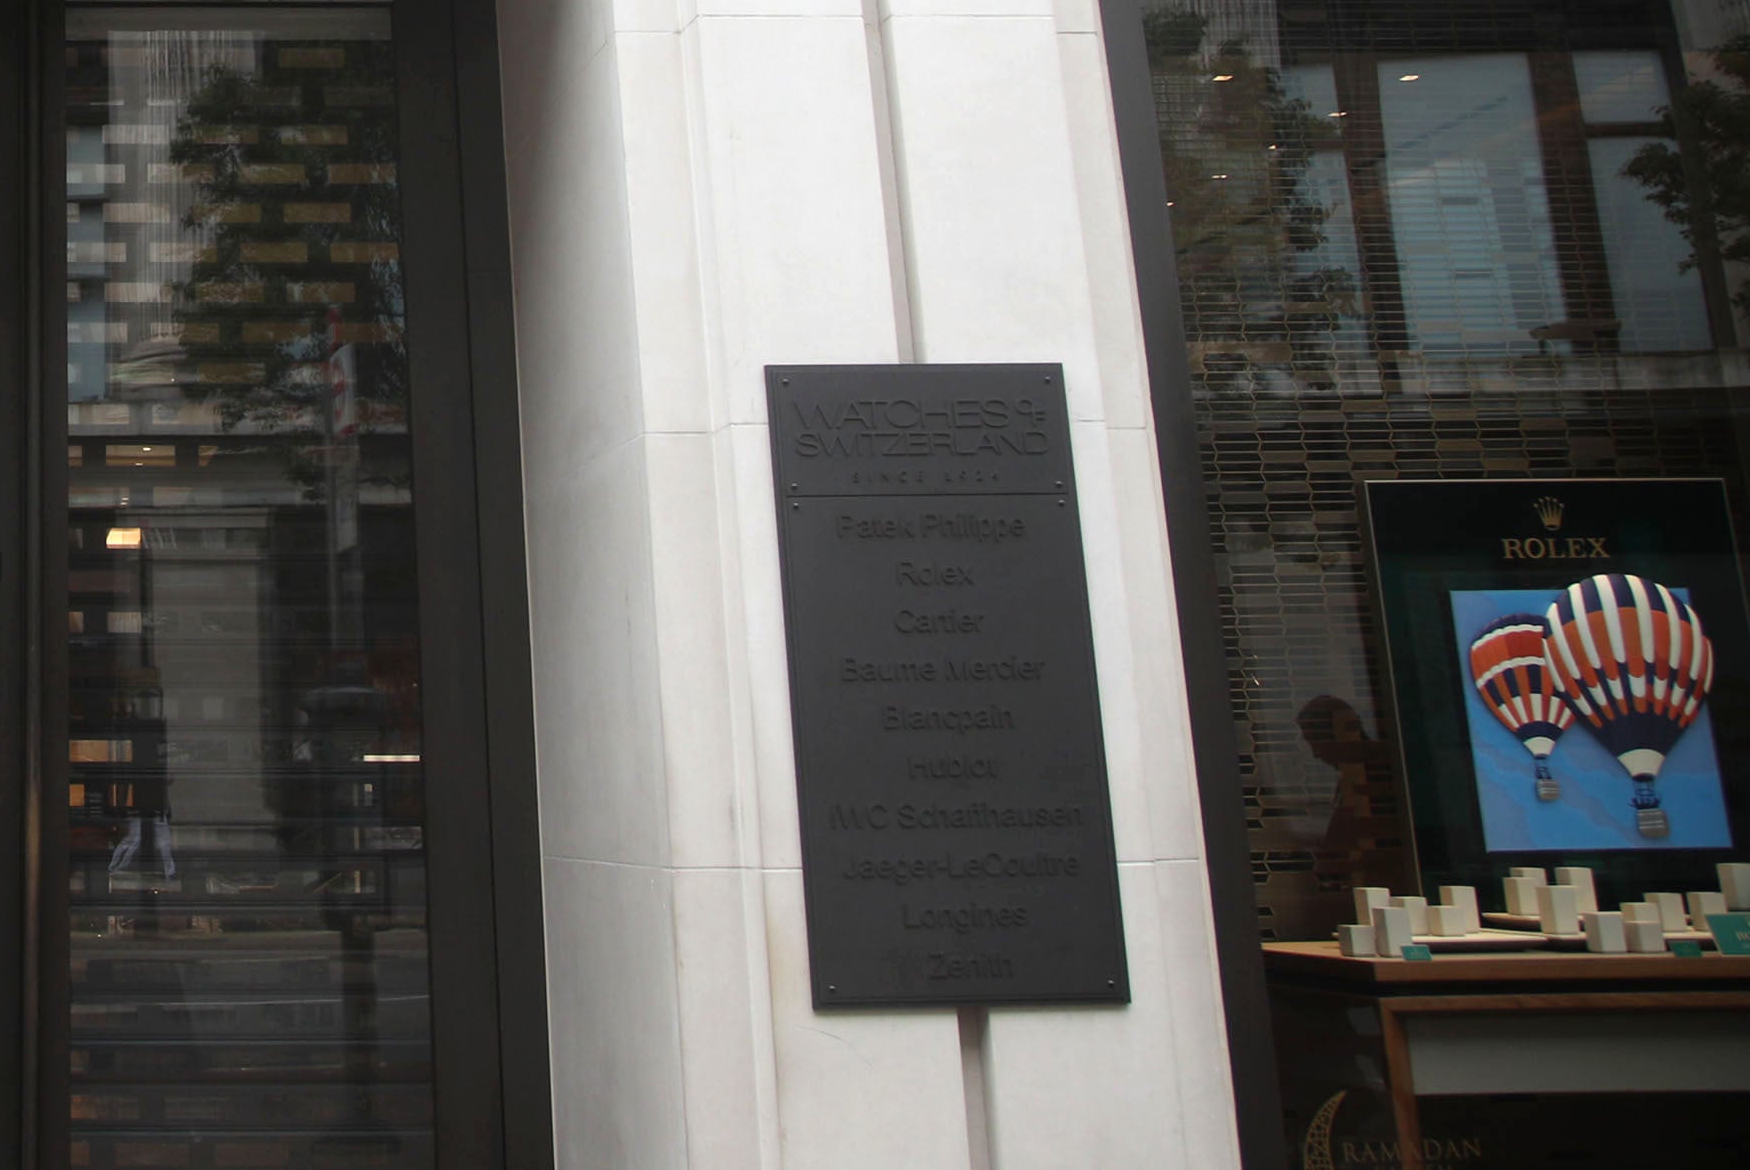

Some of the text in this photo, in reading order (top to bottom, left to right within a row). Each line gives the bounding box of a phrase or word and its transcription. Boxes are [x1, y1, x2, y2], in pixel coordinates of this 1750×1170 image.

[792, 397, 1046, 430] WATCHES OF
[795, 431, 1050, 458] SWITZERLAND
[851, 469, 924, 485] SINCE
[836, 514, 1028, 544] Patek Philippe
[1500, 537, 1611, 559] ROLEX
[897, 561, 975, 587] Rolex
[894, 609, 985, 635] Cartier
[841, 655, 1045, 683] Baume Mercier
[882, 705, 1015, 735] Blancpain
[906, 755, 999, 781] Hublot
[829, 803, 1084, 831] IWC Schaffhausen
[842, 852, 1080, 885] Jaeger-LeCoultre
[903, 903, 1028, 934] Longines
[928, 951, 1015, 981] Zenith
